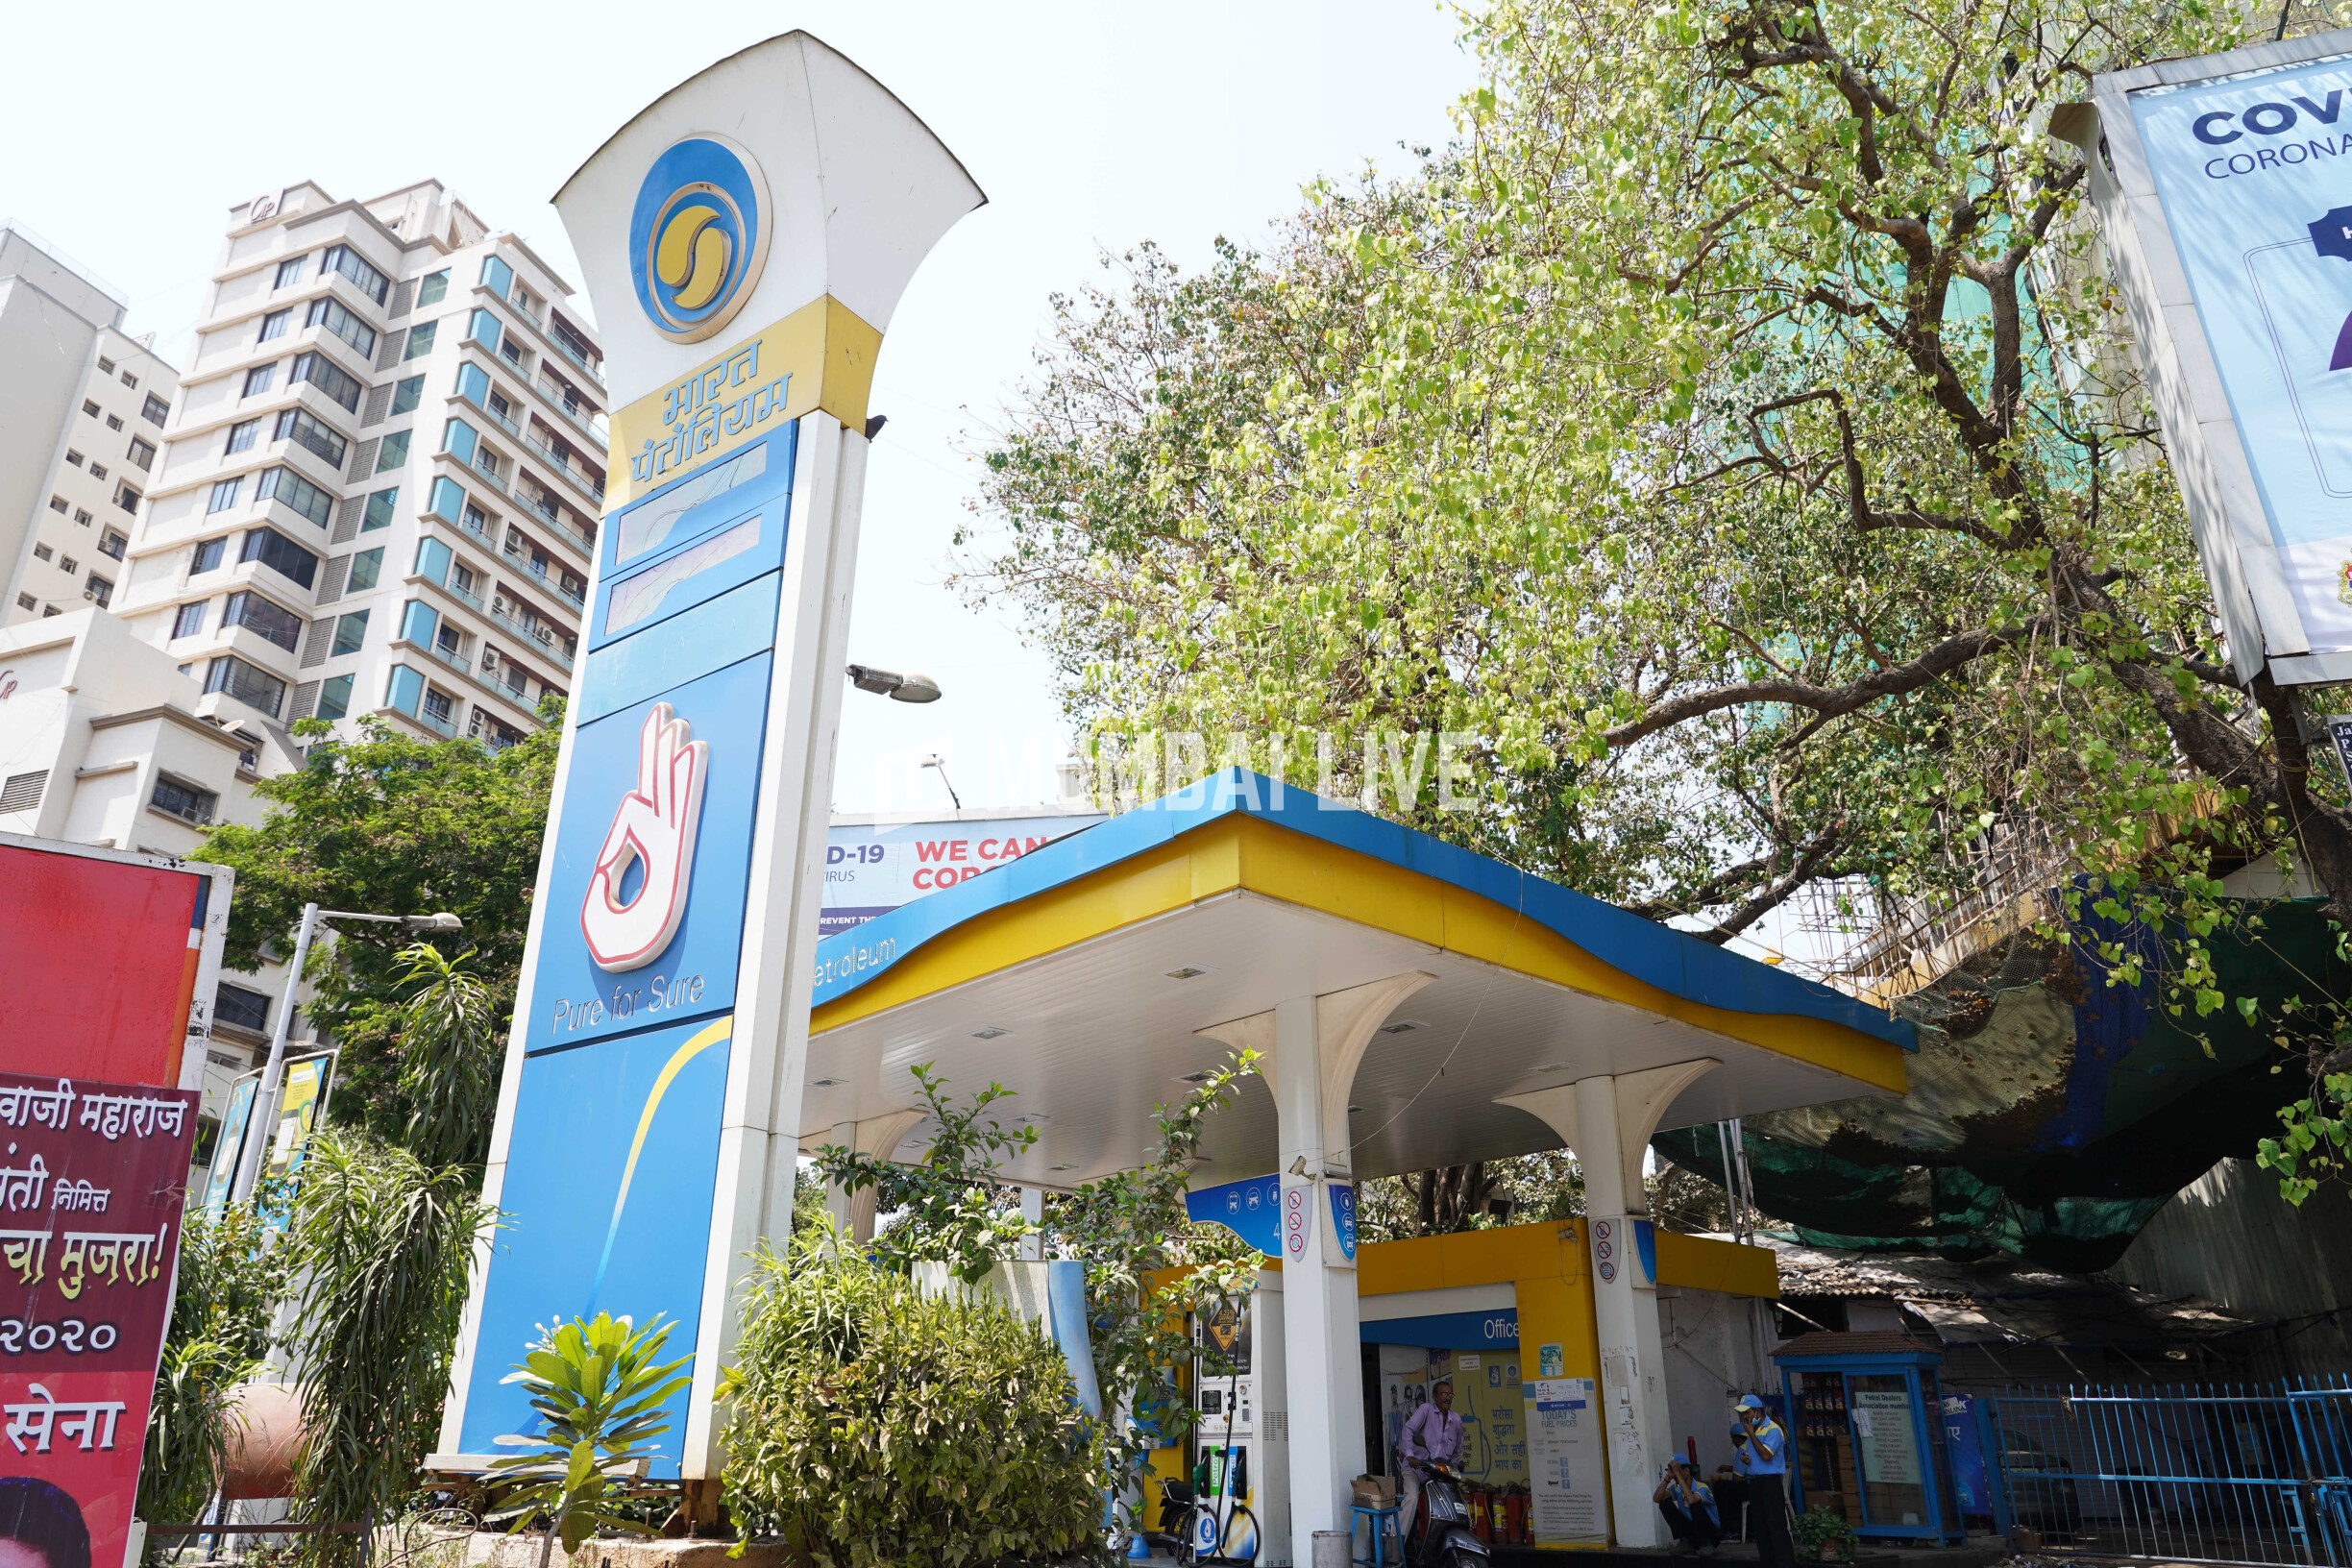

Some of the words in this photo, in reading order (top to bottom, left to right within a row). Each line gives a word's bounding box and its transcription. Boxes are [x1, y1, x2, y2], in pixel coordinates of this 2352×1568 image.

[2193, 88, 2352, 145] COV
[663, 339, 762, 426] भारत
[916, 840, 968, 862] WE
[823, 870, 855, 882] IRUS
[551, 998, 603, 1035] Pure
[611, 985, 642, 1020] for
[647, 974, 705, 1013] Sure
[81, 1093, 188, 1140] महाराज
[52, 1178, 111, 1213] निमित्त
[58, 1222, 168, 1300] मुजरा!
[1484, 1319, 1519, 1339] Office
[3, 1383, 127, 1454] सेना
[1492, 1406, 1513, 1420] भरोसा
[1541, 1409, 1577, 1420] TODAY'S
[1510, 1440, 1526, 1457] सही
[1511, 1459, 1522, 1471] का
